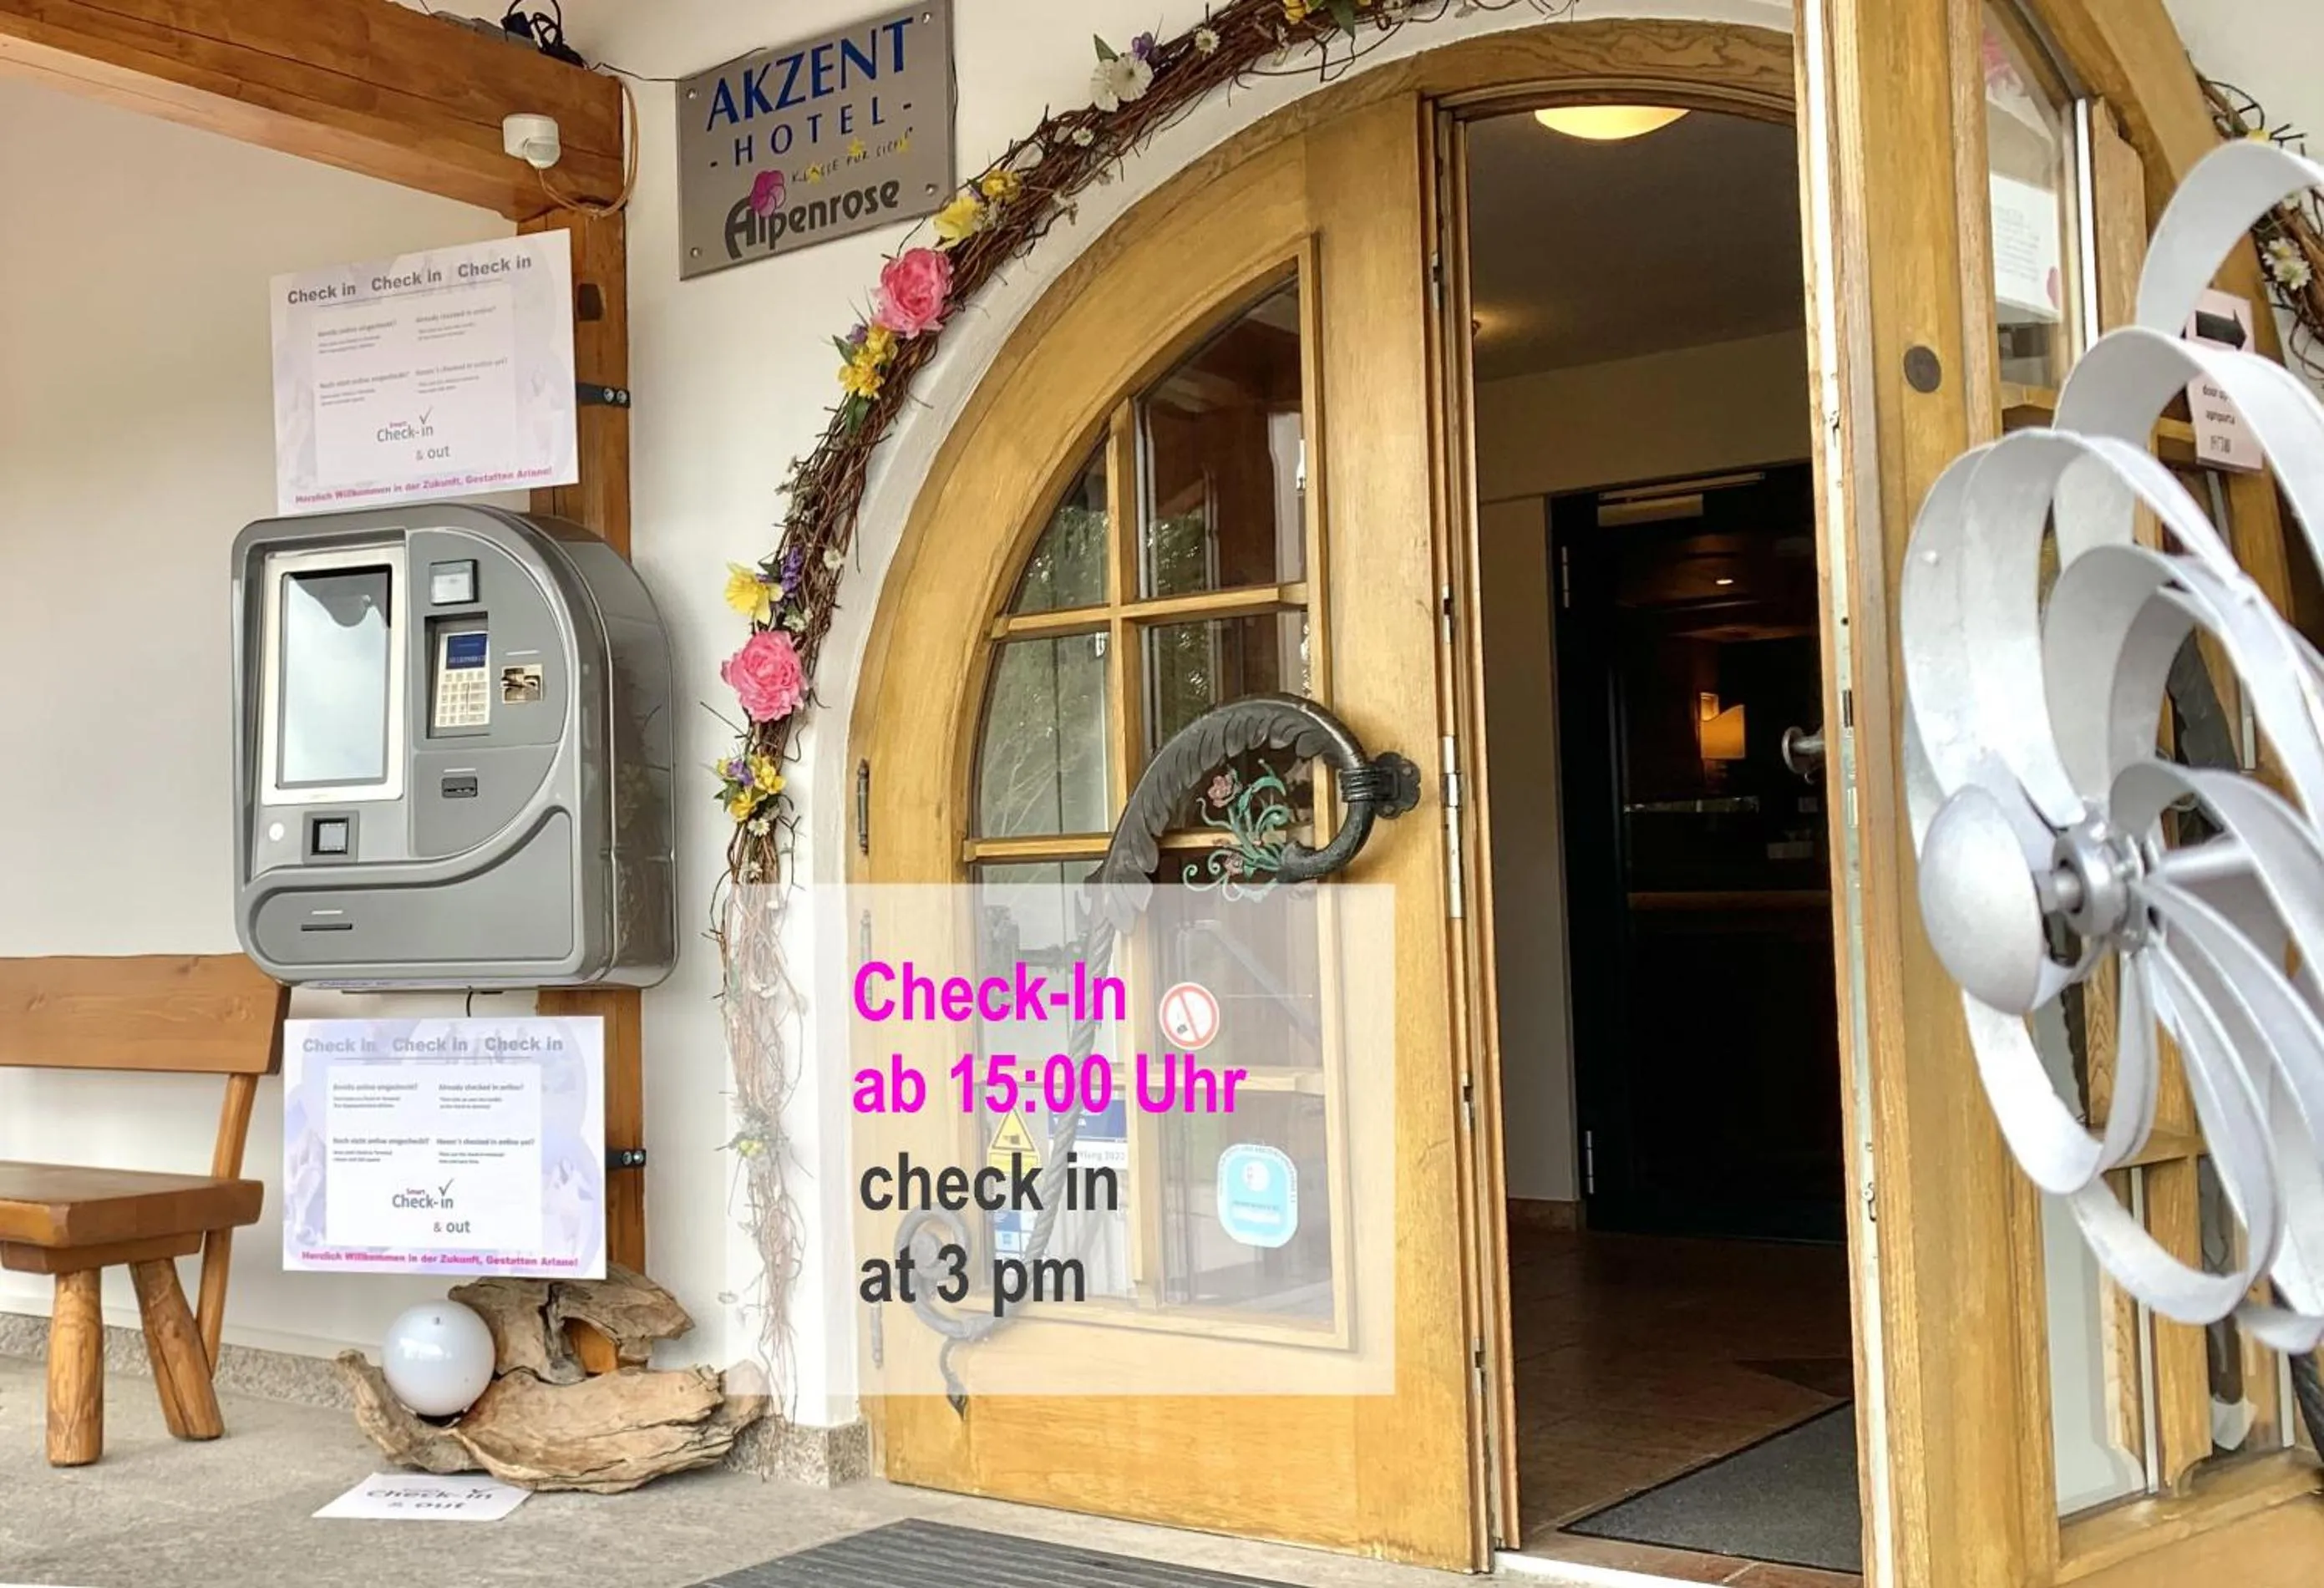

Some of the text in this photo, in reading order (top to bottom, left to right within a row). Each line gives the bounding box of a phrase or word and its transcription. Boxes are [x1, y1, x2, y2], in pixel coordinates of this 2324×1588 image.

[706, 18, 914, 132] AKZENT
[724, 179, 901, 261] Alpenrose
[288, 255, 532, 305] Check in Check in Check in
[377, 424, 434, 442] Check-in
[427, 445, 451, 459] out
[302, 1036, 563, 1053] Check in Check in Check in
[392, 1194, 454, 1210] Check-in
[434, 1220, 470, 1234] & out
[302, 1251, 343, 1261] Herzlich
[345, 1251, 405, 1262] Willkommen
[408, 1252, 418, 1263] in
[421, 1252, 437, 1264] der
[439, 1254, 484, 1266] Zukunft,
[486, 1255, 538, 1266] Gestatten
